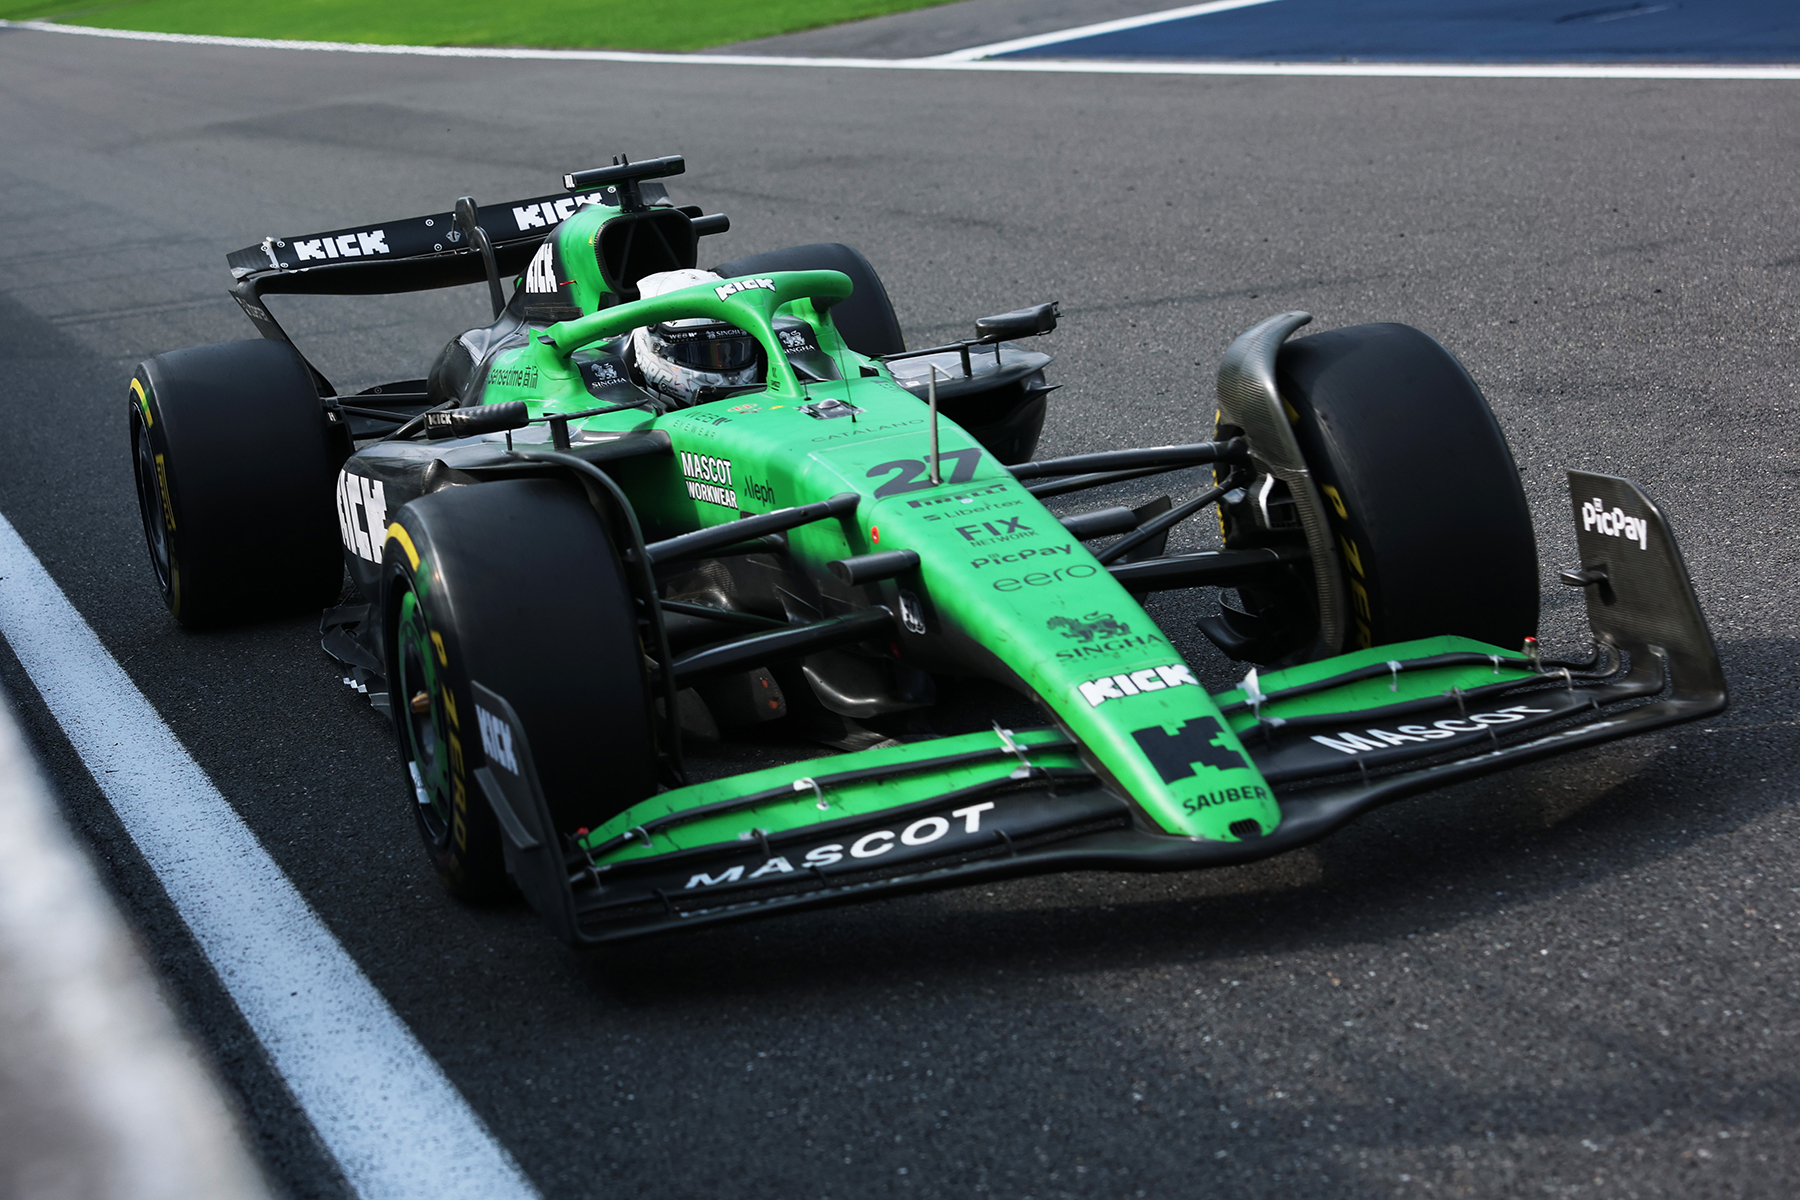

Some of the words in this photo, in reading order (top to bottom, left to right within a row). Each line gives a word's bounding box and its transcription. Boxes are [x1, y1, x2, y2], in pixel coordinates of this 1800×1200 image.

[293, 229, 390, 261] KICK
[526, 243, 557, 293] KICK
[713, 278, 776, 302] KICK
[488, 365, 523, 386] sensetime
[591, 377, 628, 389] SINGHA
[428, 413, 452, 426] KICK
[811, 418, 924, 443] CATALANO
[680, 451, 733, 486] MASCOT
[866, 447, 982, 499] 27
[685, 480, 738, 510] WORKWEAR
[944, 499, 1024, 518] Libertex
[955, 516, 1032, 541] FIX
[1582, 498, 1647, 550] PicPay
[969, 530, 1039, 548] NETWORK
[970, 544, 1072, 569] PicPay
[992, 564, 1097, 592] eero
[1056, 634, 1163, 661] SINGHA
[1077, 664, 1199, 708] KICK
[475, 703, 519, 776] KICK
[1309, 705, 1552, 754] MASCOT
[1183, 786, 1267, 816] SAUBER
[684, 801, 995, 889] MASCOT
